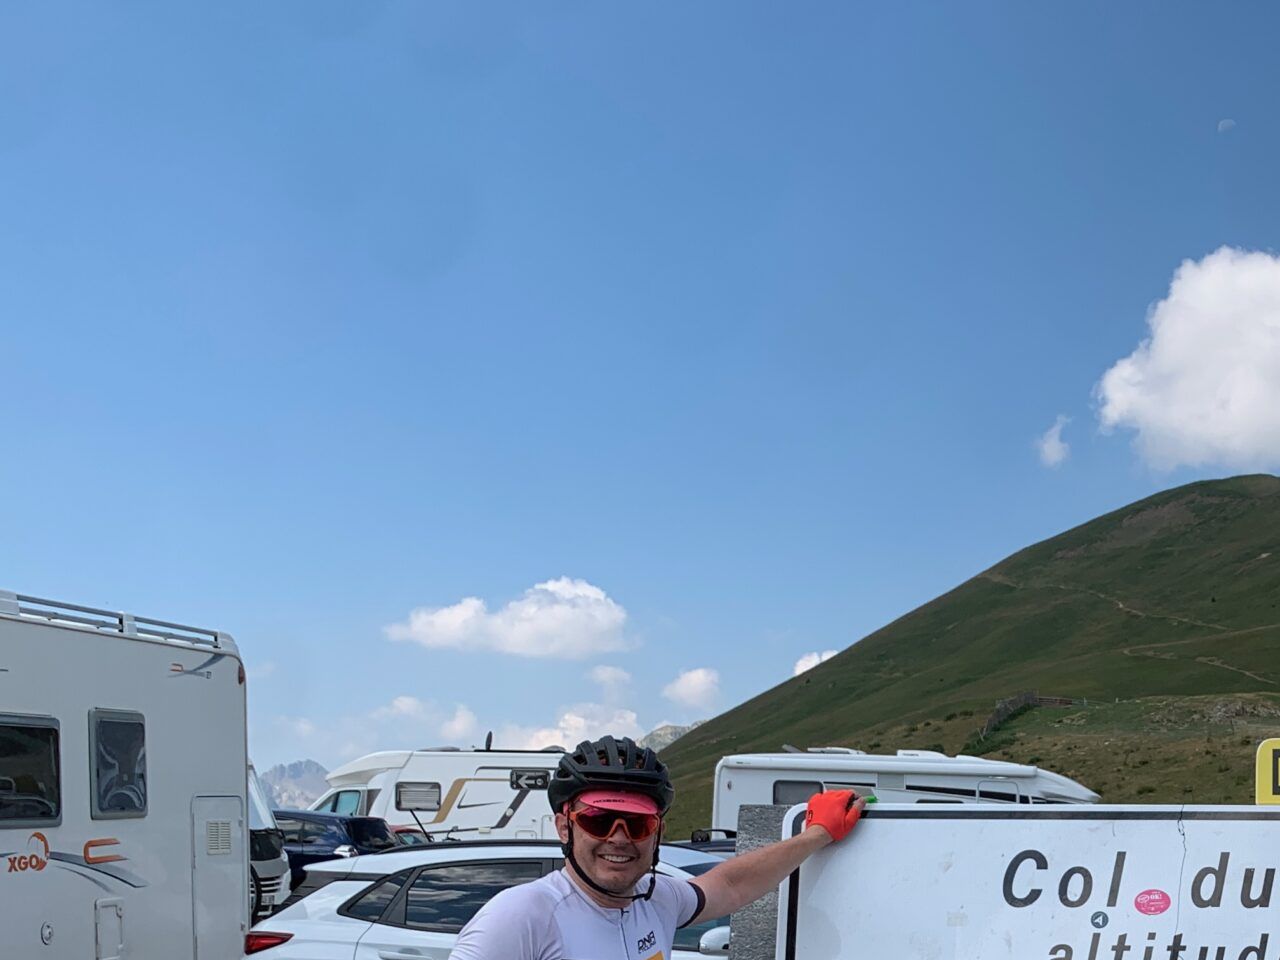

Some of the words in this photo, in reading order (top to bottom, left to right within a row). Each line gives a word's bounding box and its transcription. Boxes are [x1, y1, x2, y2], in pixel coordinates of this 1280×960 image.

[8, 854, 40, 873] XGO
[1003, 850, 1126, 908] Col
[1192, 853, 1275, 908] du
[637, 930, 656, 950] DNA
